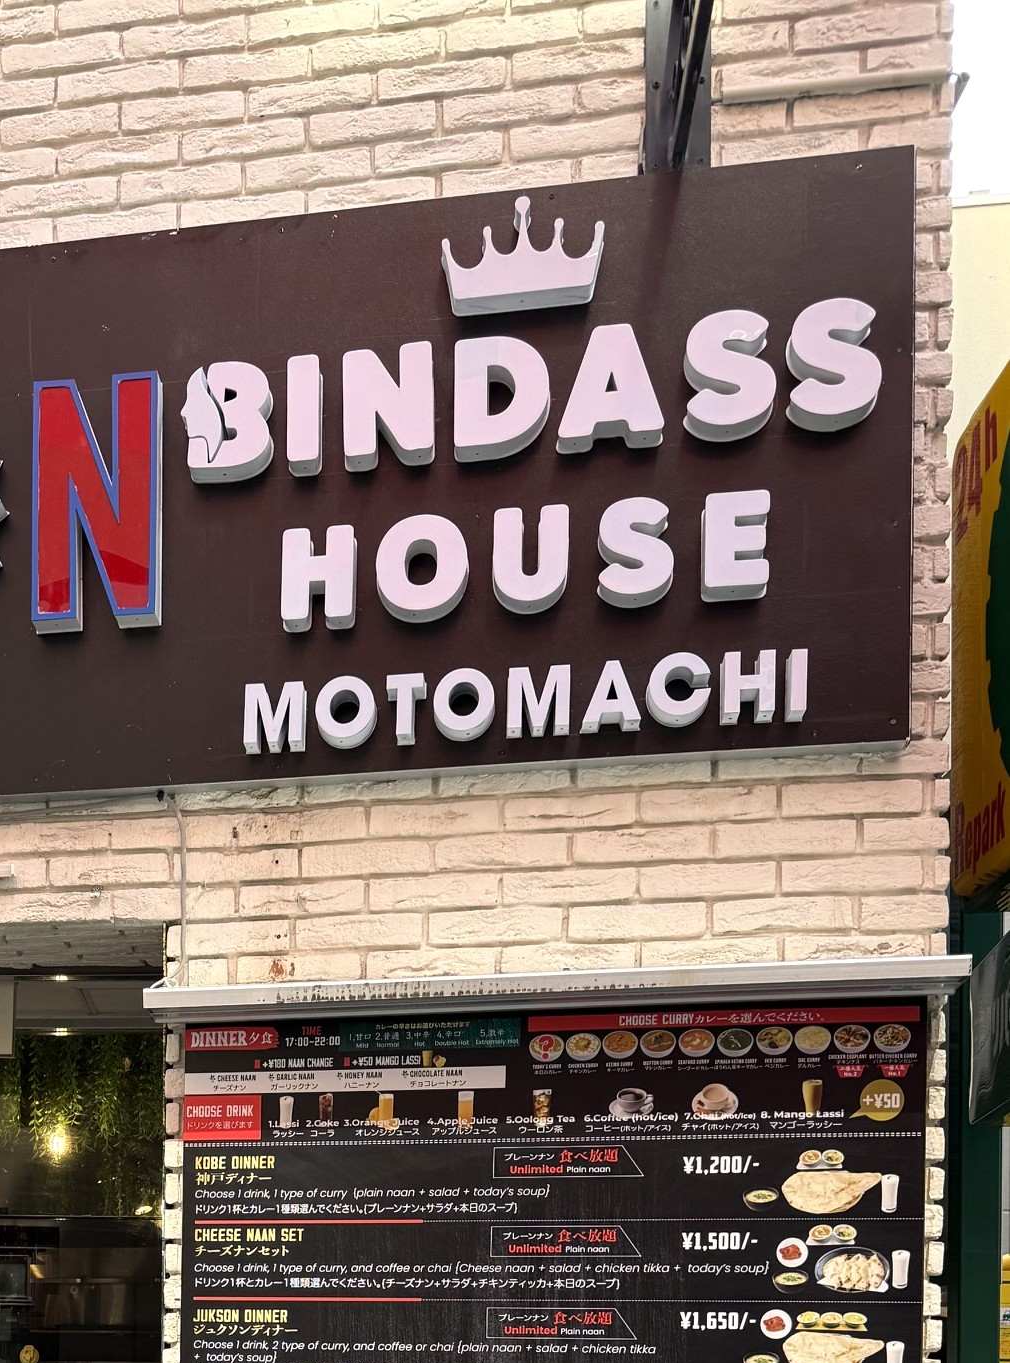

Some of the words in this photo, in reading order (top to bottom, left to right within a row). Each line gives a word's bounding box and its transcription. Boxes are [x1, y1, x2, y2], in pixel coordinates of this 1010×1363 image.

[182, 298, 882, 483] BINDASS
[281, 489, 771, 632] HOUSE
[243, 648, 808, 755] MOTOMACHI
[191, 1031, 246, 1048] DINNER
[249, 1031, 272, 1044] 夕食
[187, 1106, 223, 1118] CHOOSE
[227, 1105, 253, 1117] DRINK
[559, 1150, 618, 1162] 食べ放題
[195, 1156, 228, 1170] KOBE
[232, 1156, 274, 1169] DINNER
[509, 1164, 563, 1174] Unlimited
[683, 1156, 760, 1174] ¥1,200/-
[195, 1173, 272, 1185] 神戸ディナー
[195, 1189, 235, 1199] Choose
[279, 1189, 301, 1199] type
[303, 1188, 317, 1197] of
[321, 1189, 348, 1199] curry
[386, 1189, 416, 1197] naan
[428, 1188, 459, 1196] salad
[473, 1186, 514, 1198] today's
[195, 1229, 241, 1242] CHEESE
[246, 1229, 277, 1242] NAAN
[281, 1229, 304, 1242] SET
[682, 1232, 758, 1250] ¥1,500/-
[195, 1245, 289, 1257] チーズナンセット
[194, 1310, 239, 1322] JUKSON
[244, 1310, 288, 1322] DINNER
[680, 1312, 756, 1330] ¥1,650/-
[194, 1324, 298, 1336] ジュクソンディナー
